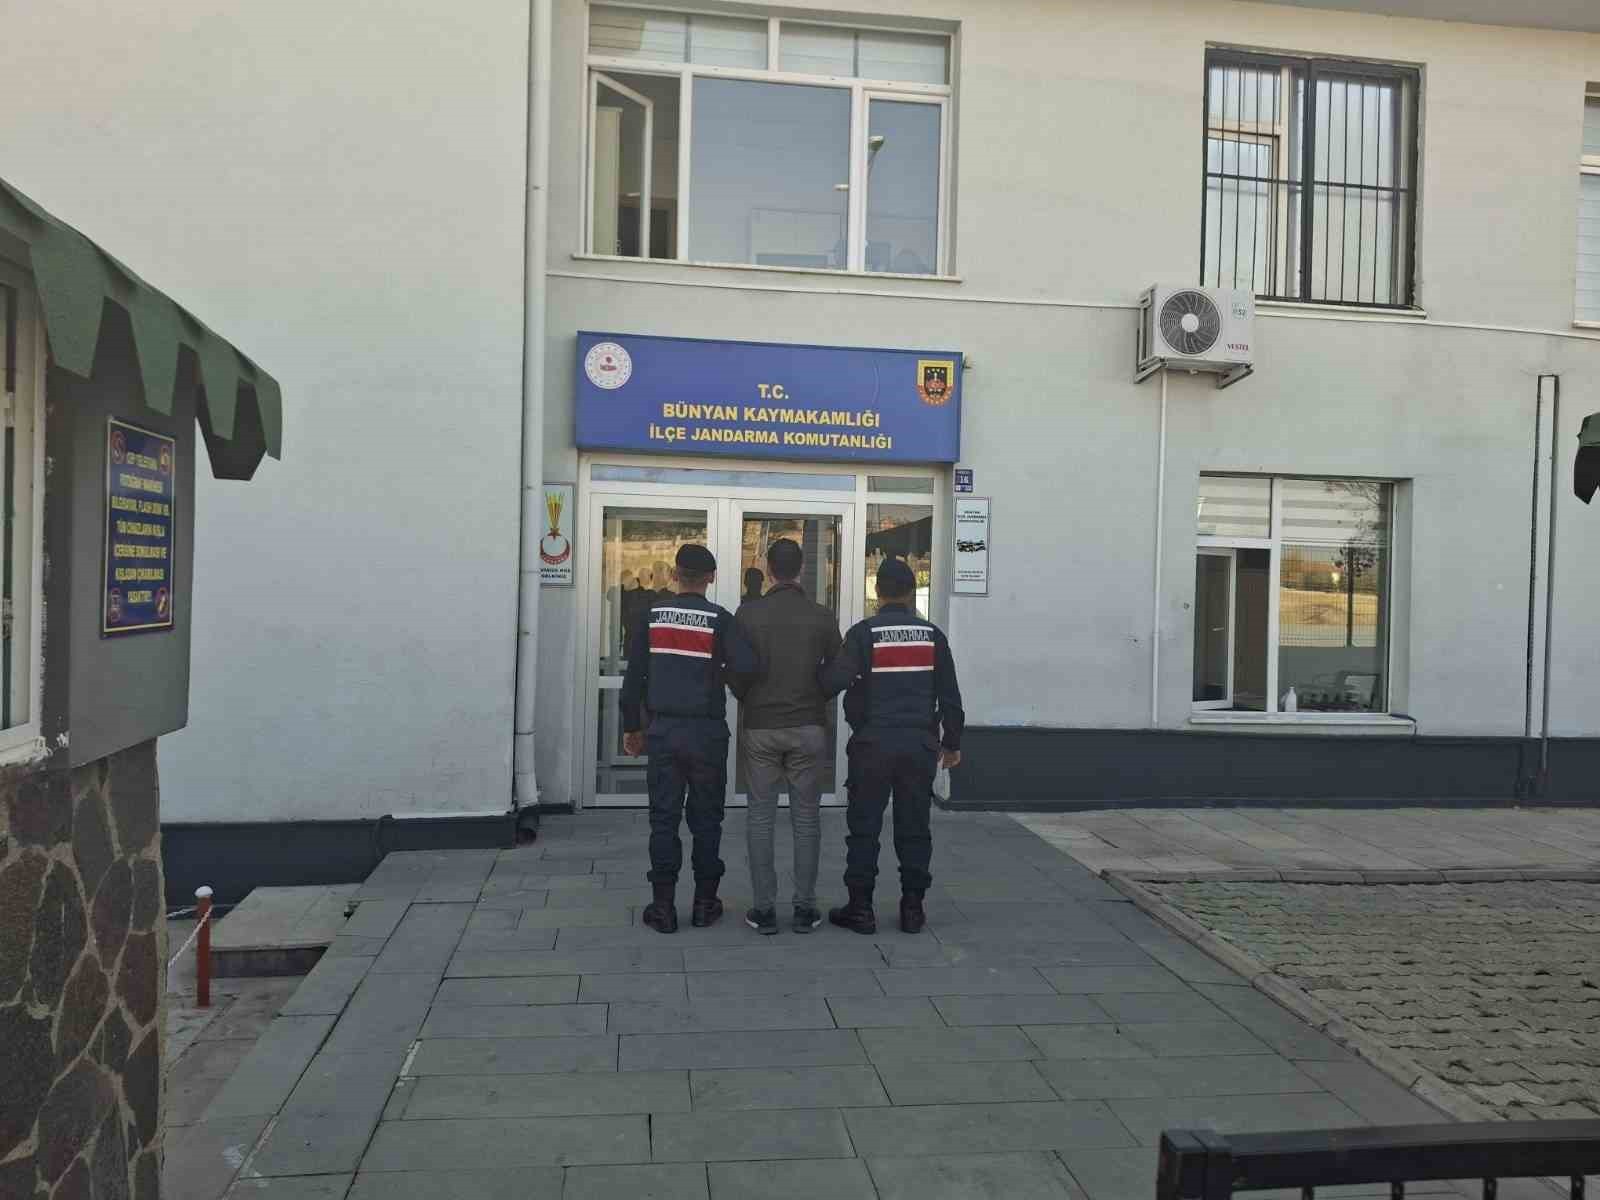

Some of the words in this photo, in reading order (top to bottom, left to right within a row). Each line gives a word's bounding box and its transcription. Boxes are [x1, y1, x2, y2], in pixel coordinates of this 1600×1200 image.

[758, 383, 789, 400] T.C.
[663, 401, 738, 420] BÜNYAN
[744, 407, 880, 428] KAYMAKAMLIĞI
[649, 423, 686, 442] İLÇE
[691, 428, 779, 444] JANDARMA
[784, 431, 892, 449] KOMUTANLIĞI
[656, 611, 708, 626] JANDARMA
[880, 630, 930, 641] JANDARMA
